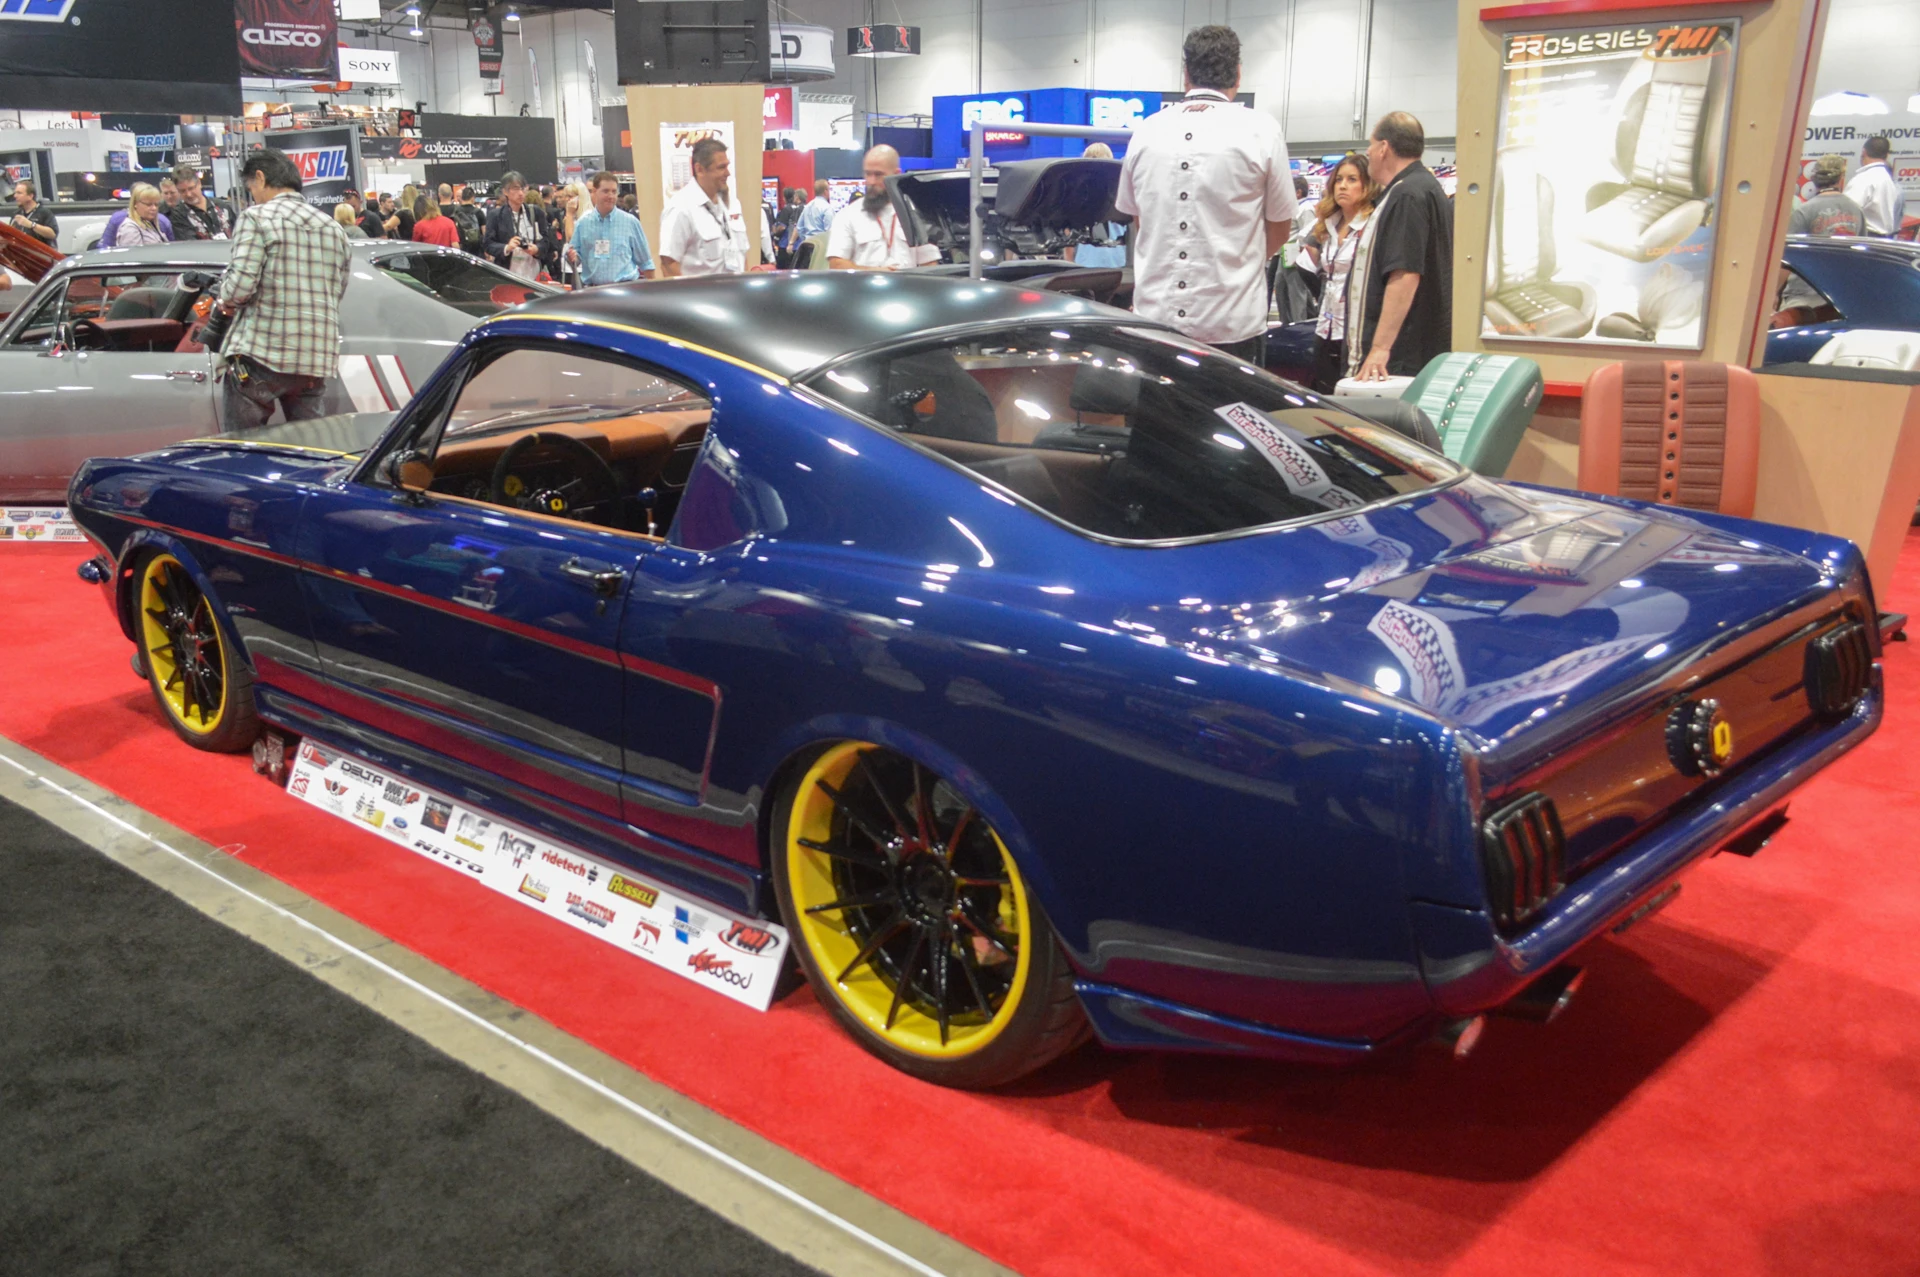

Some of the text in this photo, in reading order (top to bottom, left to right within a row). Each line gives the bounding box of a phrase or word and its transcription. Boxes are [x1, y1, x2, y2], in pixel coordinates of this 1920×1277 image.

[242, 28, 321, 47] CUSCO
[1508, 28, 1651, 59] PROSERIES
[1654, 26, 1720, 57] TMI
[348, 60, 392, 72] SONY
[47, 120, 74, 130] Let's
[136, 133, 176, 147] BRANT
[287, 150, 346, 179] MSOIL
[341, 761, 384, 786] DELTA
[414, 839, 484, 874] NITTO
[542, 850, 586, 877] ridetech
[726, 919, 772, 954] TMI
